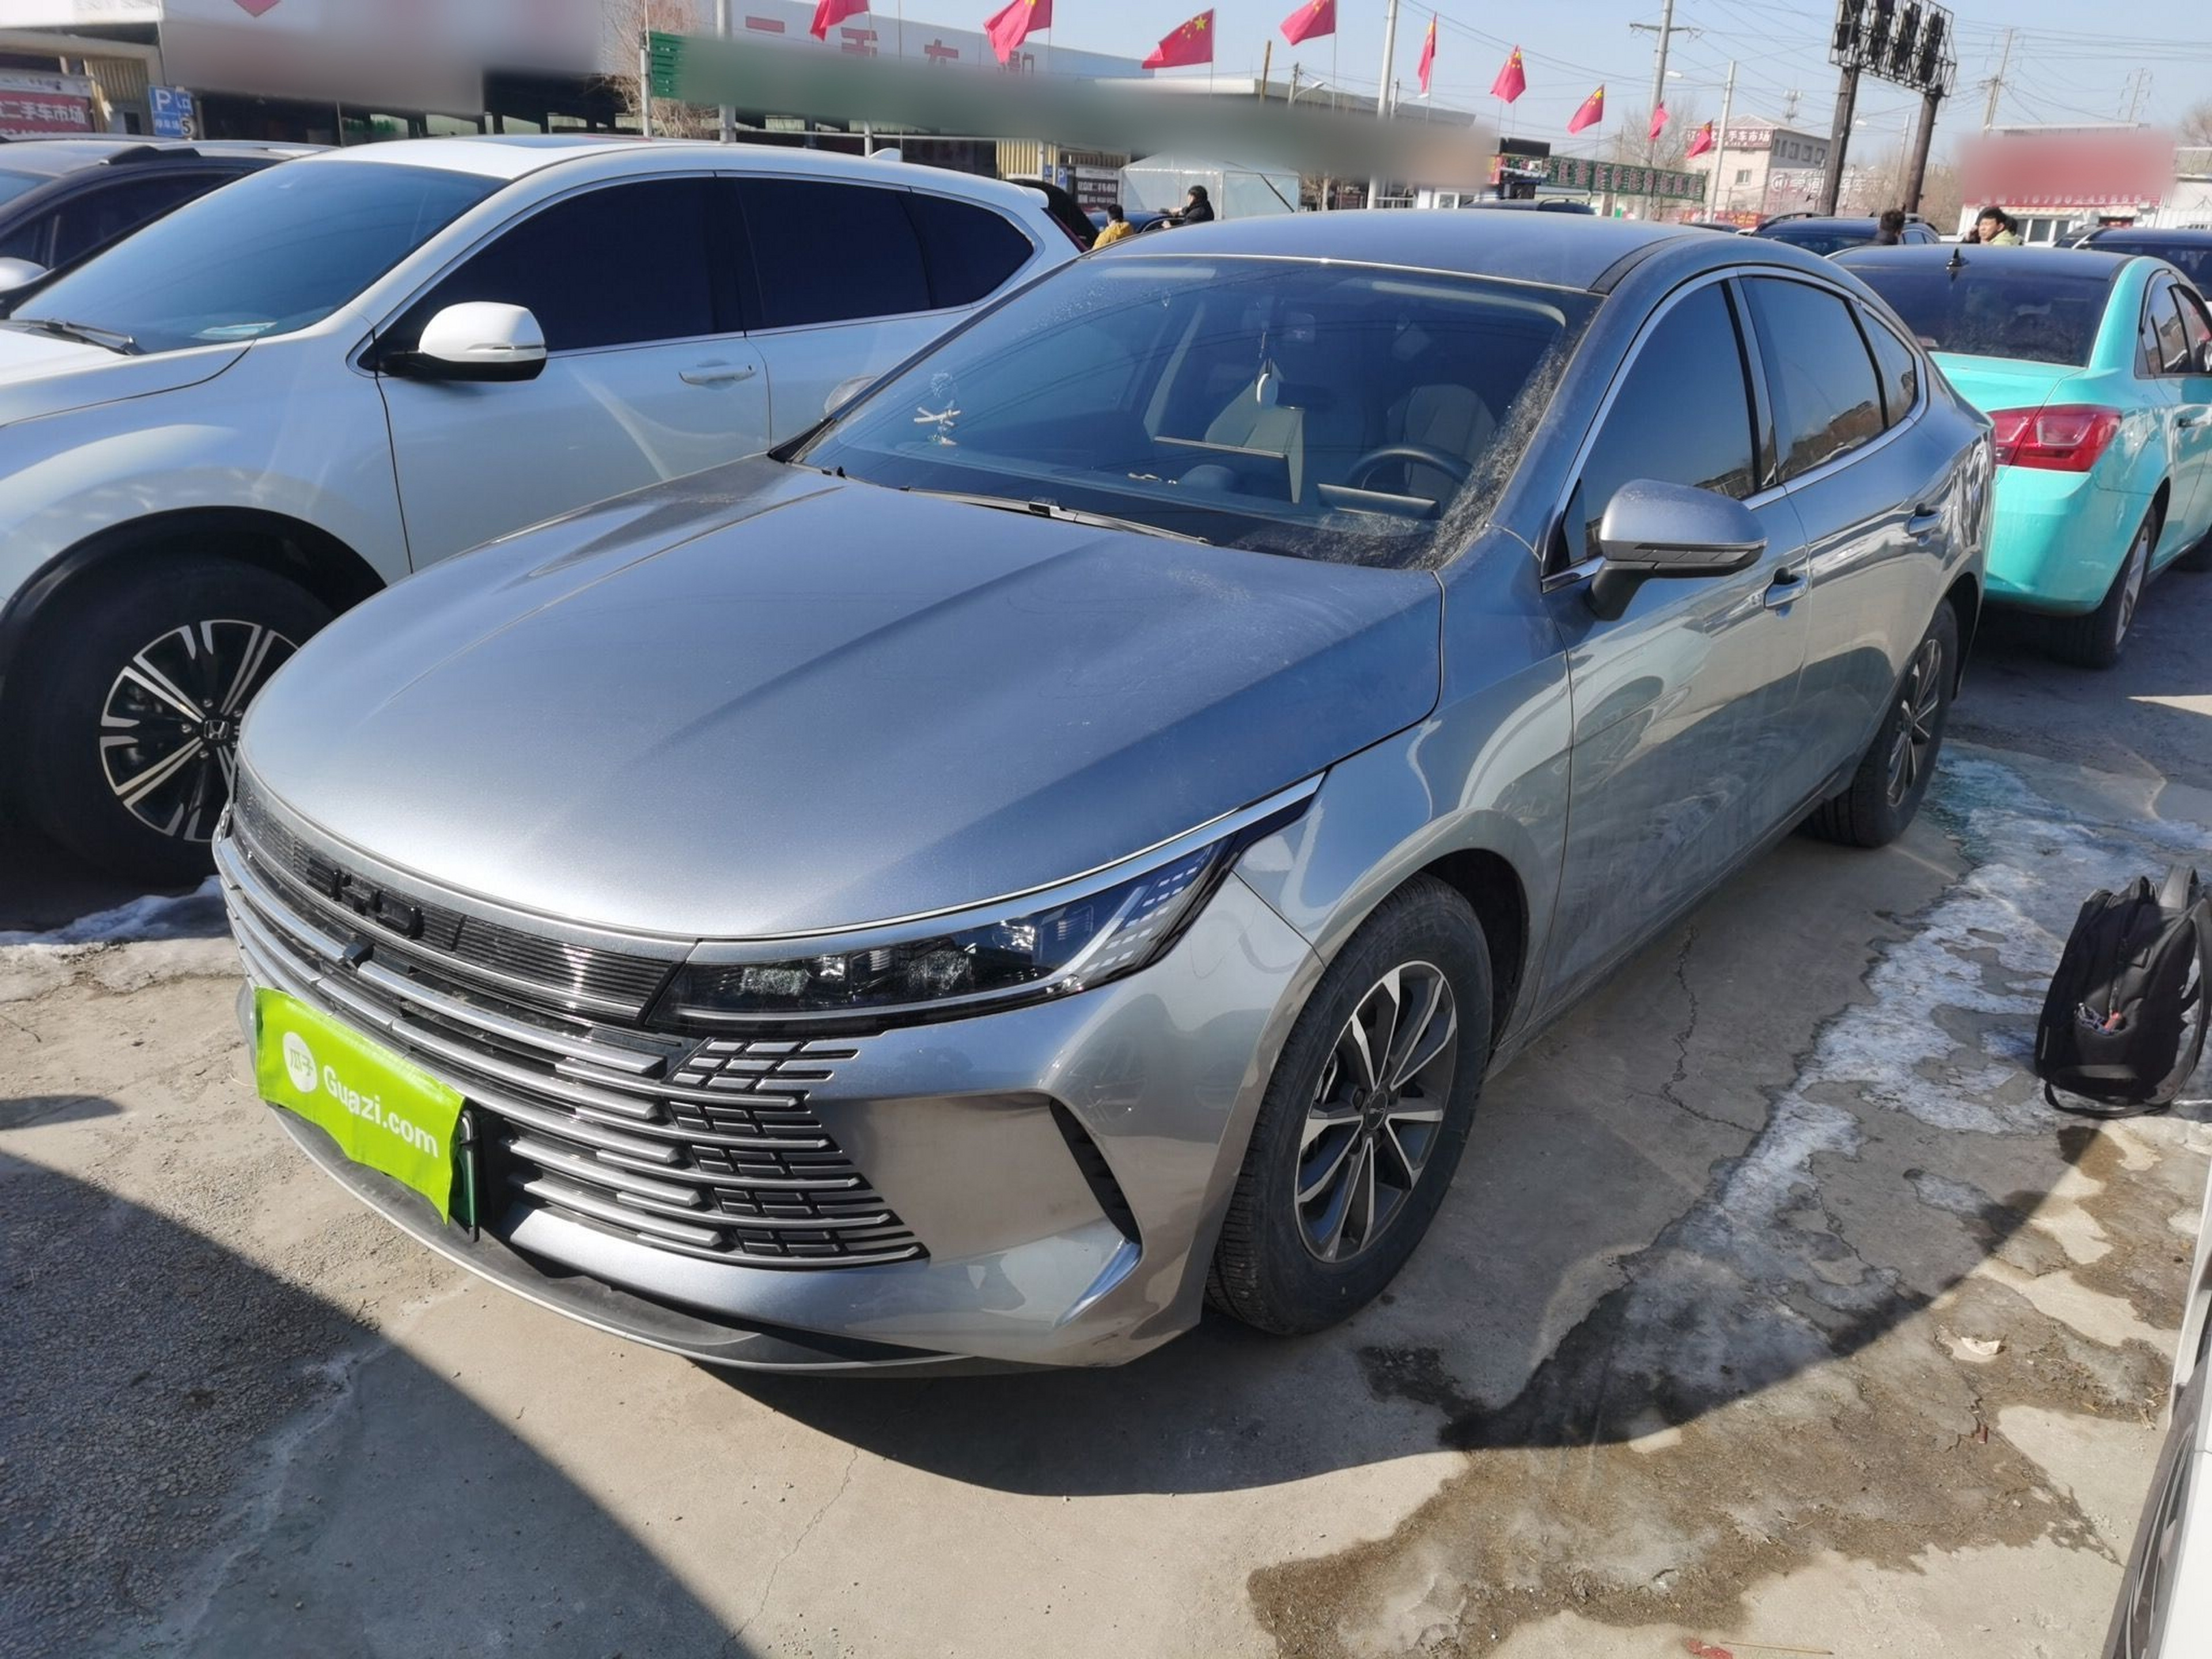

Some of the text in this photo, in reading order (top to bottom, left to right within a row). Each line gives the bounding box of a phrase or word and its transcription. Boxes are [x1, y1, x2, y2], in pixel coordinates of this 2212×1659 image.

[156, 89, 172, 111] P
[182, 120, 191, 134] 5
[324, 1065, 439, 1158] Guazi.com
